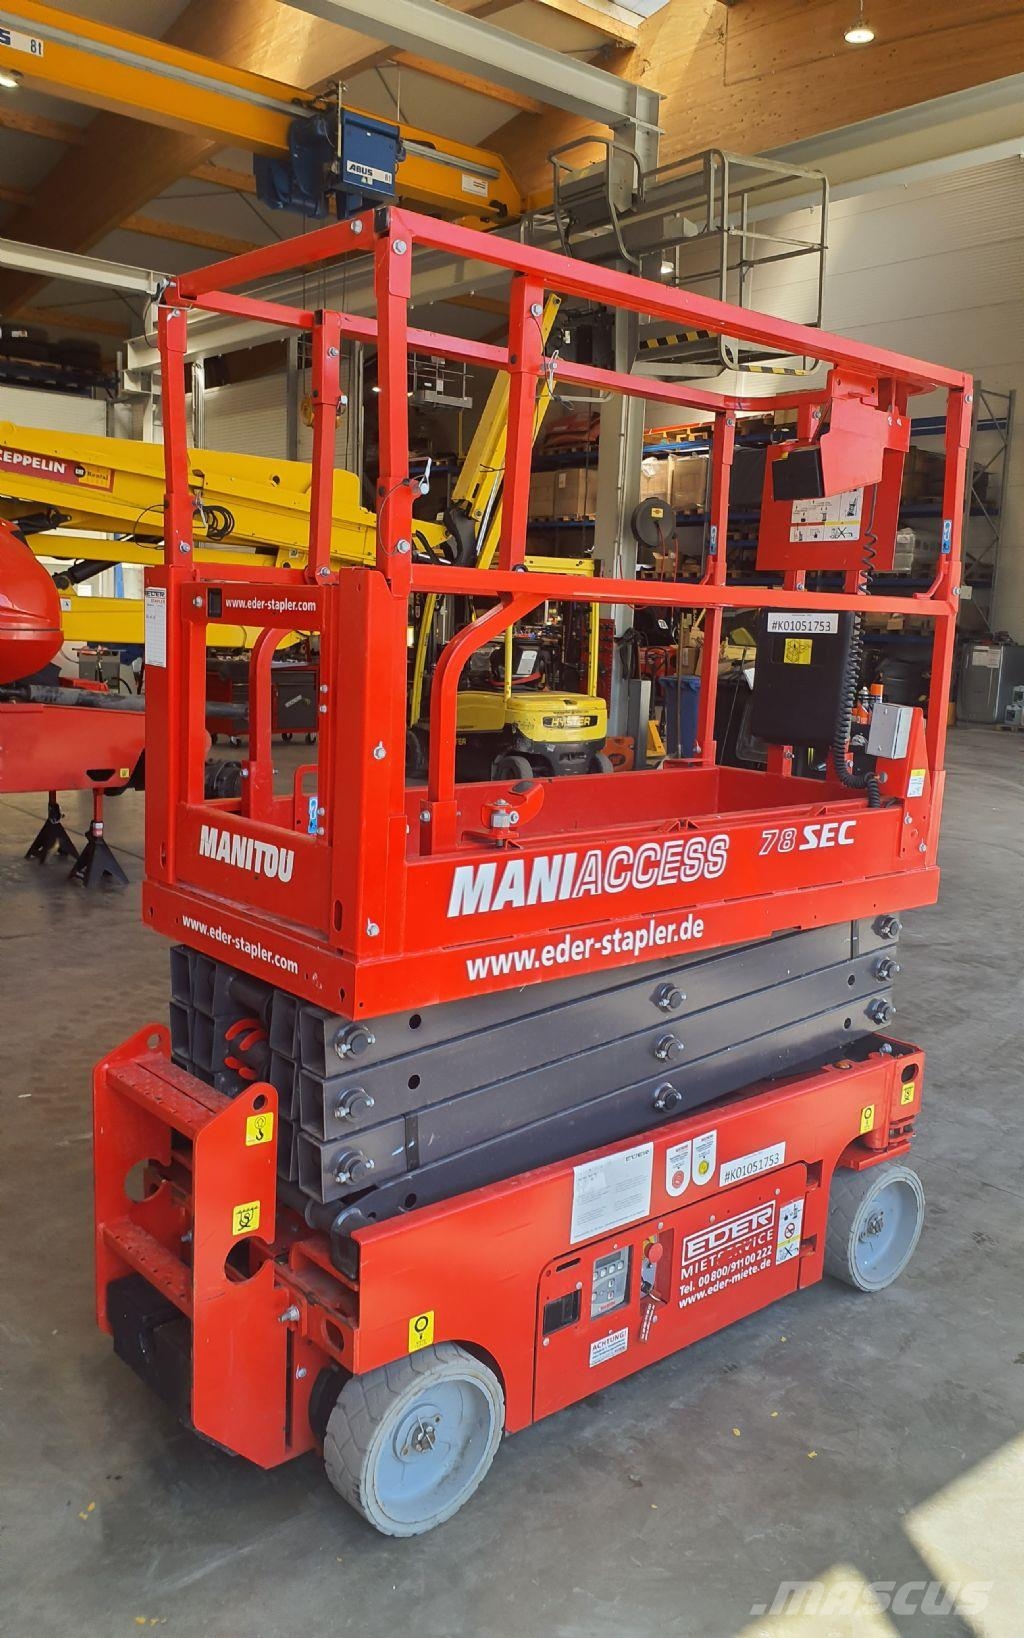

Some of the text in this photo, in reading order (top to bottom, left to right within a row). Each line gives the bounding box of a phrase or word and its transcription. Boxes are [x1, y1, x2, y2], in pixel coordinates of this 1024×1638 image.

[349, 163, 373, 177] ABUS
[0, 449, 66, 474] EPPELIN
[225, 597, 316, 613] www.eder-stapler.com
[771, 620, 831, 632] #K01051753
[551, 716, 591, 729] HYSTER
[199, 824, 295, 883] MANITOU
[758, 820, 857, 856] 78 SEC
[446, 834, 730, 919] MANIACCESS
[182, 915, 299, 975] www.eder-stapler.com
[466, 913, 705, 981] www.eder-stapler.de
[724, 1152, 780, 1183] #K01051753
[686, 1206, 773, 1259] EDER
[678, 1258, 771, 1309] www.eder-miete.de
[679, 1280, 695, 1296] Tel.
